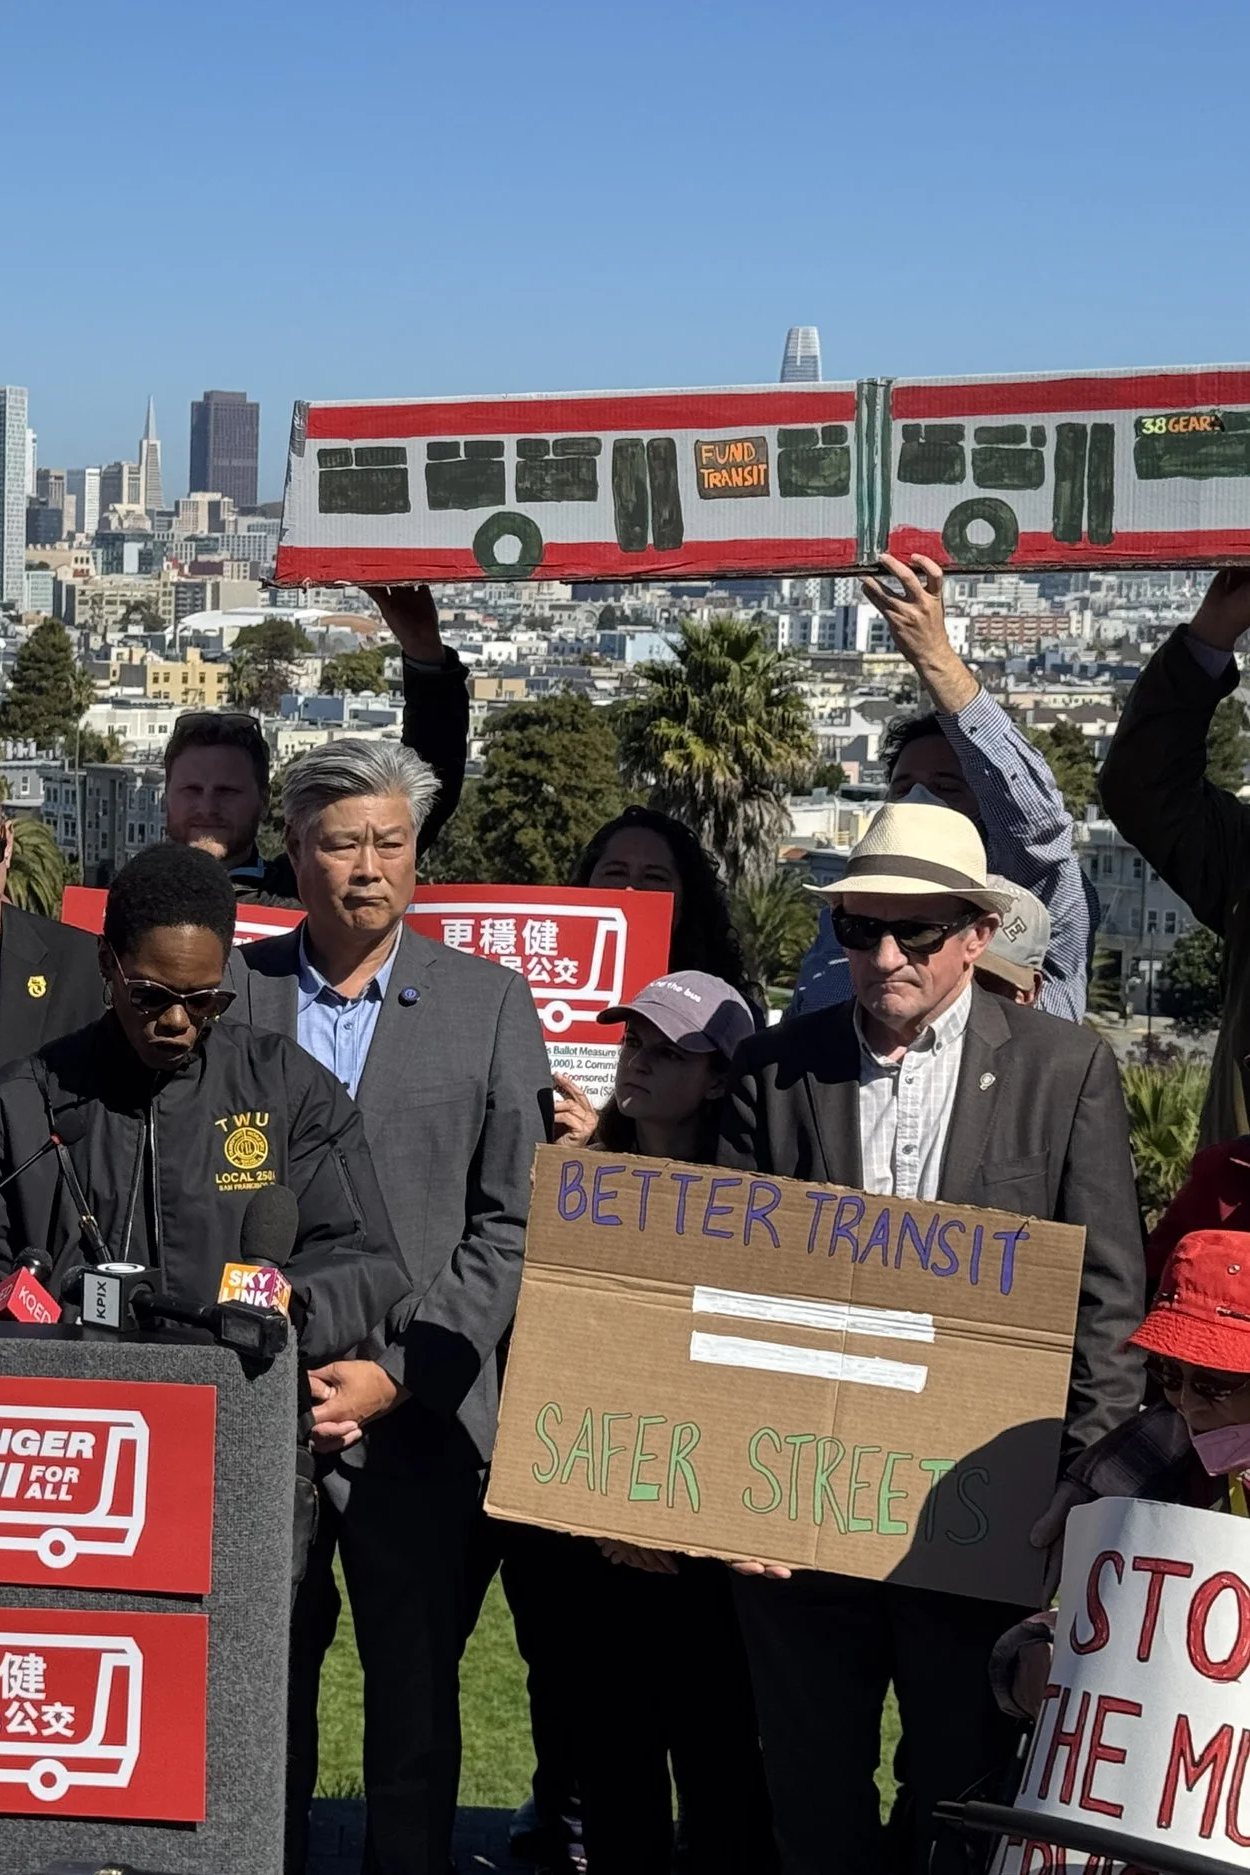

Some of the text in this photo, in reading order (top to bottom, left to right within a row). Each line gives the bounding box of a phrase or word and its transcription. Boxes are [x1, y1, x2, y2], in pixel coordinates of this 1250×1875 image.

[1141, 417, 1167, 435] 38
[701, 442, 756, 465] FUND
[700, 464, 767, 489] TRANSIT
[441, 918, 559, 956] 更穩健
[1003, 916, 1027, 943] E
[479, 955, 579, 984] 民公交
[667, 981, 683, 992] the
[553, 1045, 577, 1055] Ballot
[579, 1046, 617, 1057] Measure
[215, 1111, 269, 1132] TWU
[215, 1171, 255, 1184] LOCAL
[557, 1159, 1030, 1296] BETTER TRANSIT
[228, 1269, 272, 1290] SKY
[18, 1285, 53, 1323] KQED
[96, 1281, 107, 1319] KPIX
[221, 1287, 270, 1308] LINK
[29, 1465, 80, 1484] FOR
[532, 1401, 991, 1546] SAFER STREETS
[24, 1483, 73, 1501] ALL
